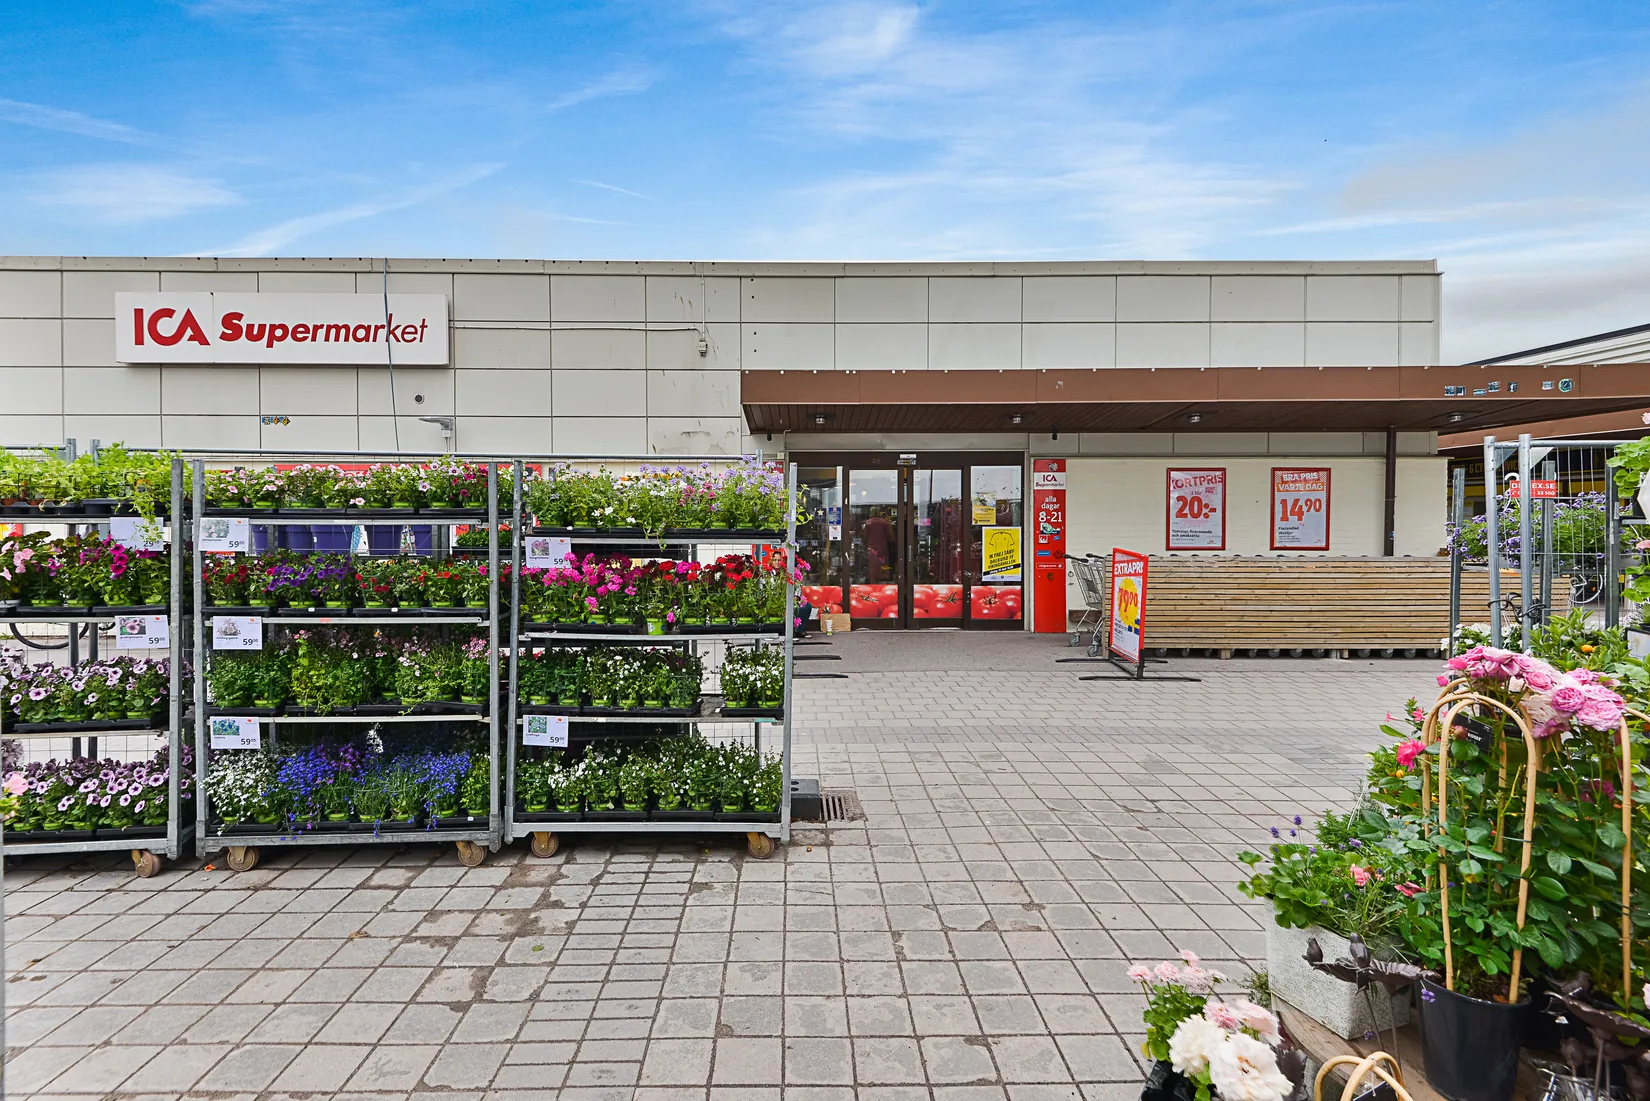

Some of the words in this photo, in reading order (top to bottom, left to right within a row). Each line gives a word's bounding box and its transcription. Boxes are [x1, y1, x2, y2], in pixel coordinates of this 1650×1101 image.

[133, 307, 211, 346] ICA
[219, 311, 428, 348] Supermarket
[1042, 474, 1057, 482] ICA
[1283, 473, 1299, 482] BRA
[1301, 472, 1318, 480] PRIS
[1279, 483, 1304, 491] VARJE
[1305, 483, 1323, 491] DAG
[1041, 502, 1060, 511] dagar
[1038, 511, 1062, 523] 8-21
